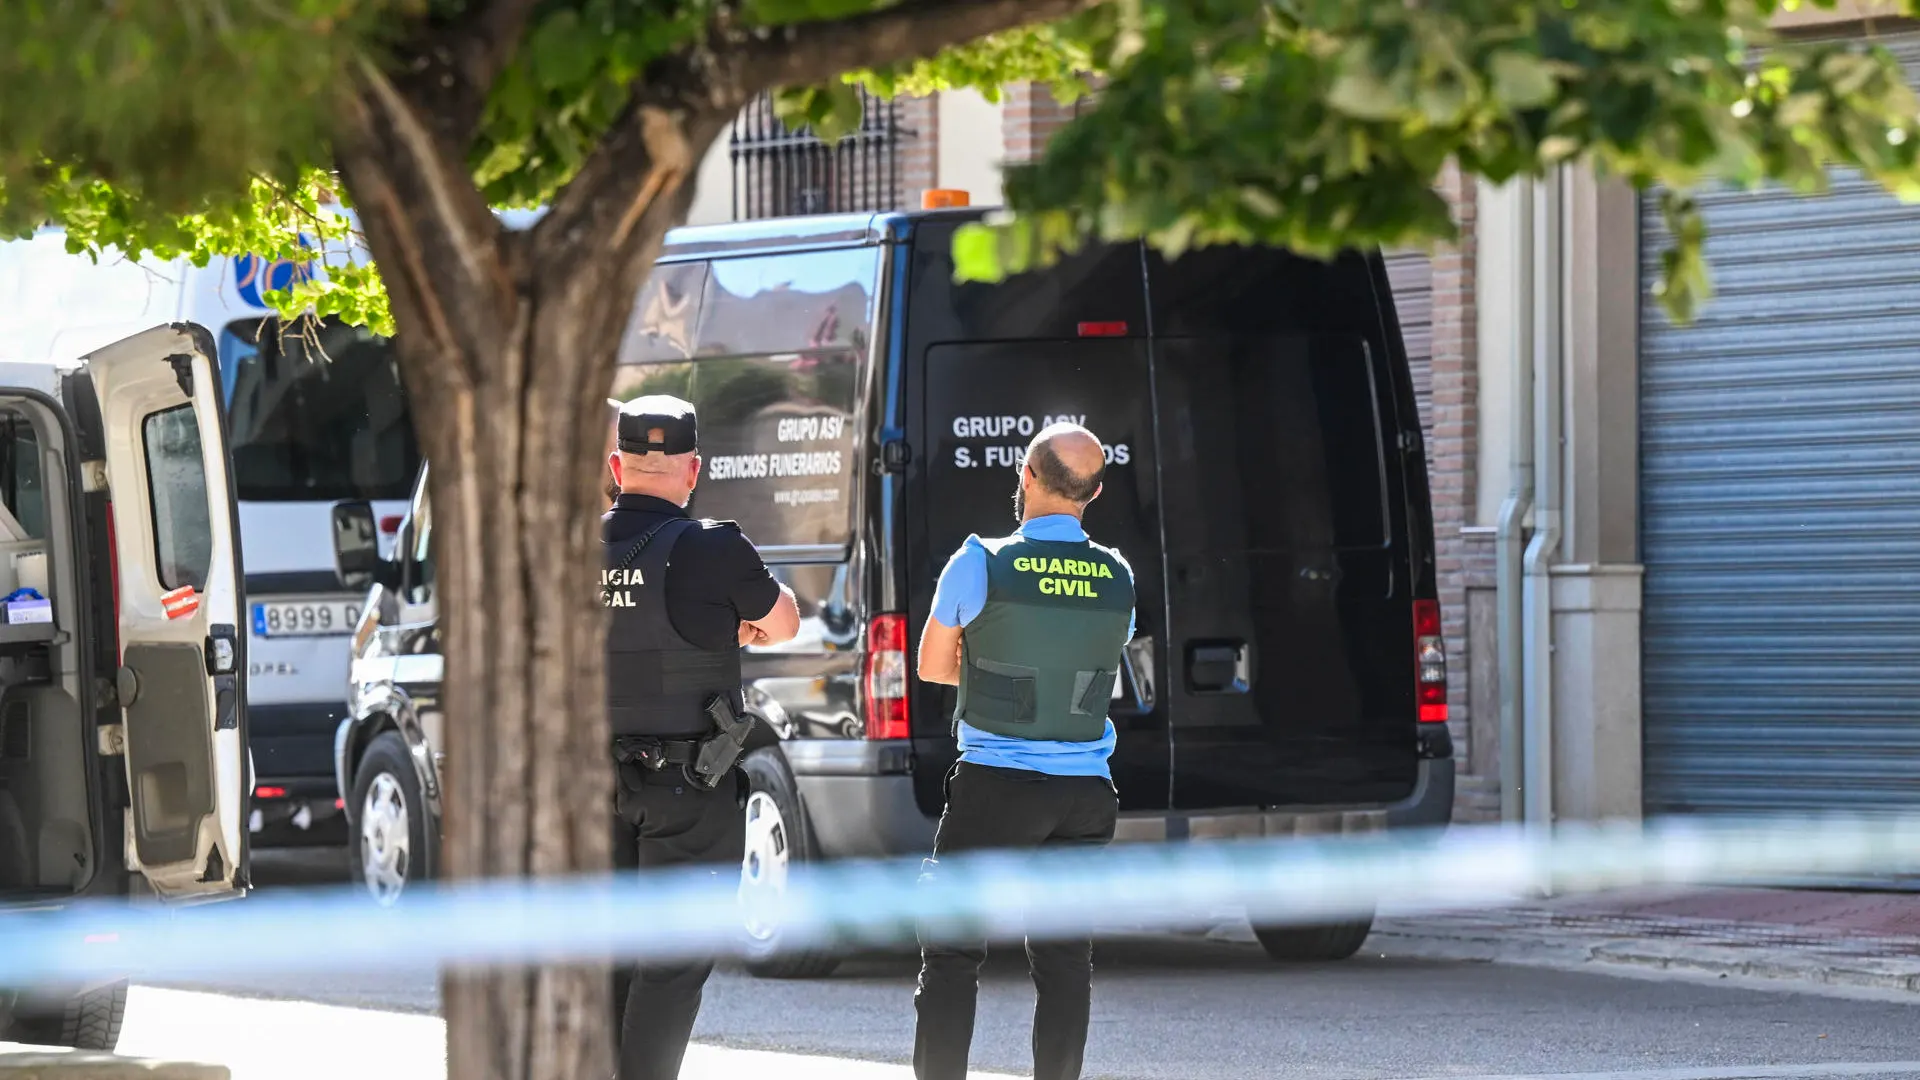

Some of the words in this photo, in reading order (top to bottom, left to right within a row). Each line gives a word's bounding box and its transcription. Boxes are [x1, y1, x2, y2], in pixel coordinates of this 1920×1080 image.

[778, 417, 818, 442] GRUPO
[819, 416, 845, 440] ASV
[953, 415, 1034, 437] GRUPO
[709, 454, 767, 480] SERVICIOS
[769, 451, 841, 477] FUNERARIOS
[954, 446, 978, 468] S.
[598, 569, 644, 586] ICIA
[1013, 557, 1114, 579] GUARDIA
[1038, 578, 1098, 598] CIVIL
[268, 607, 332, 630] 8999
